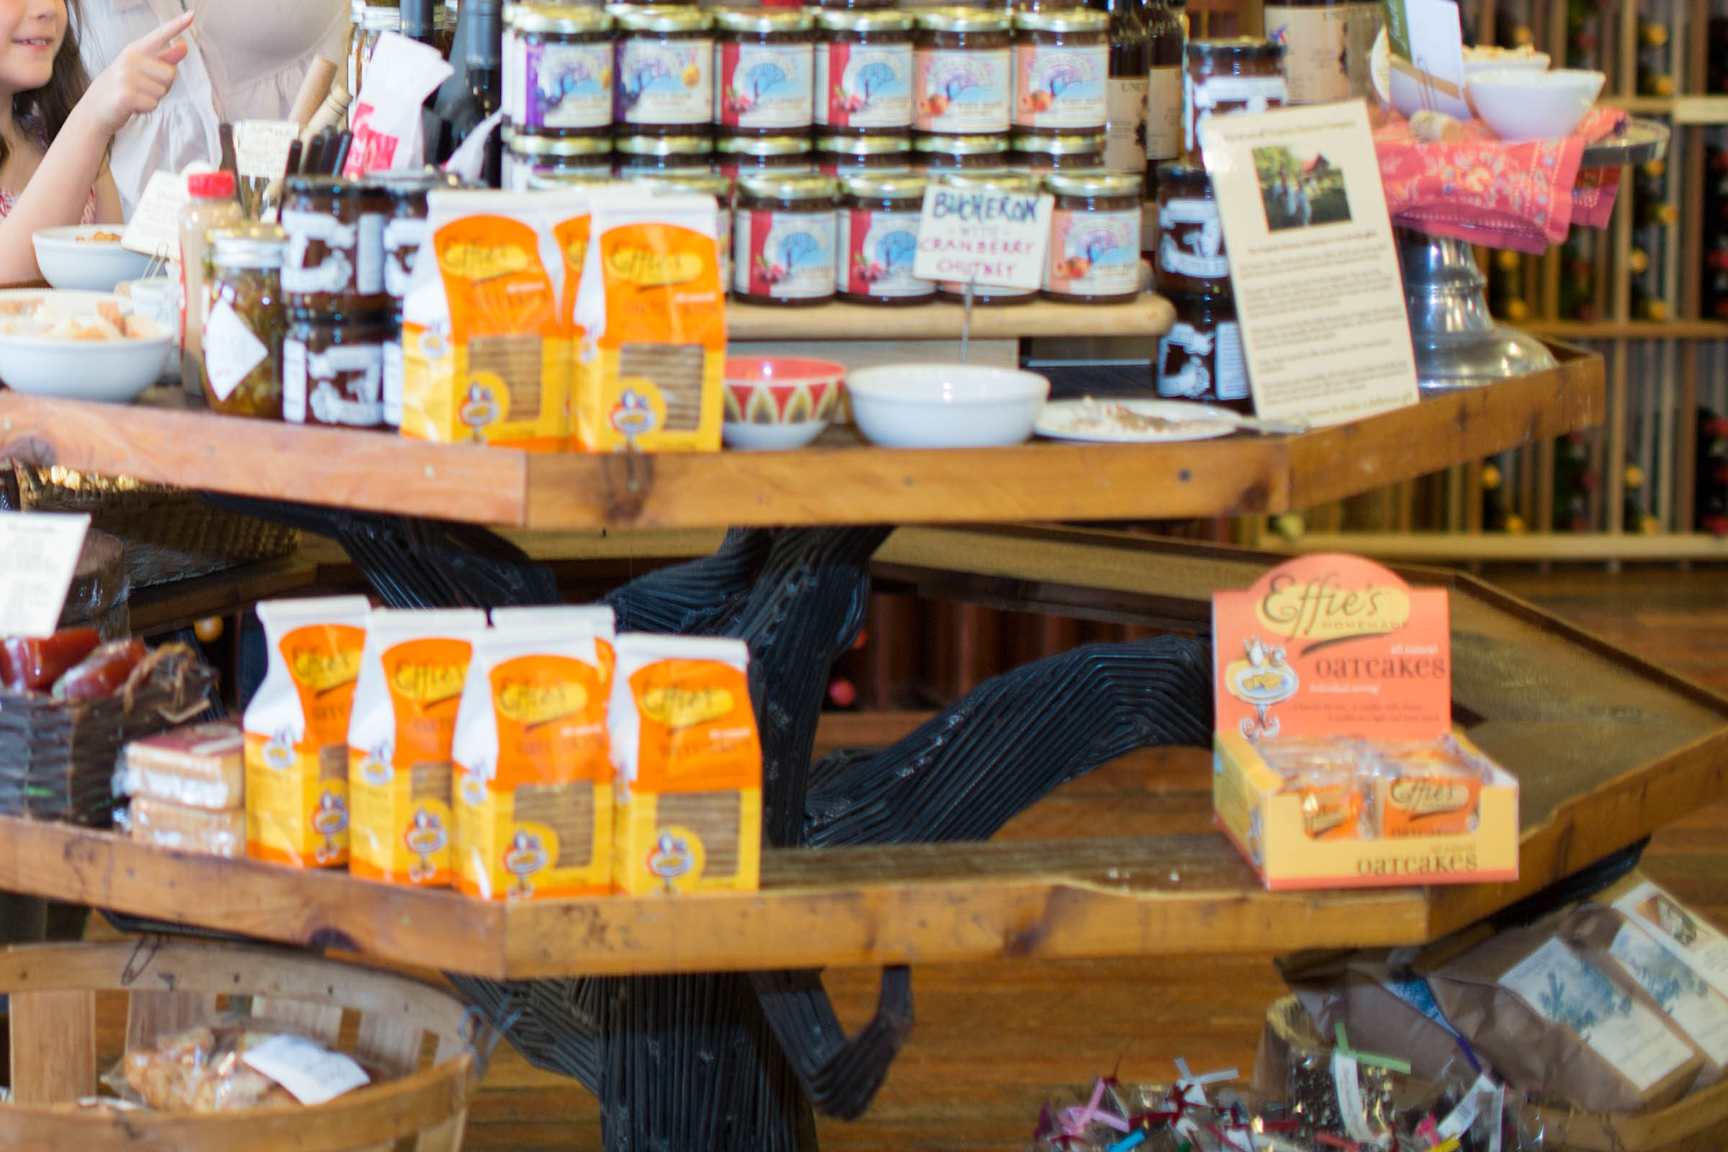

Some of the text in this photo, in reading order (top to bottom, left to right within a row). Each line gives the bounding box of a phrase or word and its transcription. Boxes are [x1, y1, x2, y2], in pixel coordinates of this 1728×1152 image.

[920, 236, 1035, 255] CRANBERRY
[936, 258, 1017, 278] CHUTNEY
[1262, 573, 1386, 642] Effie's
[1315, 656, 1447, 680] oatcakes
[1356, 852, 1480, 878] oatcakes
